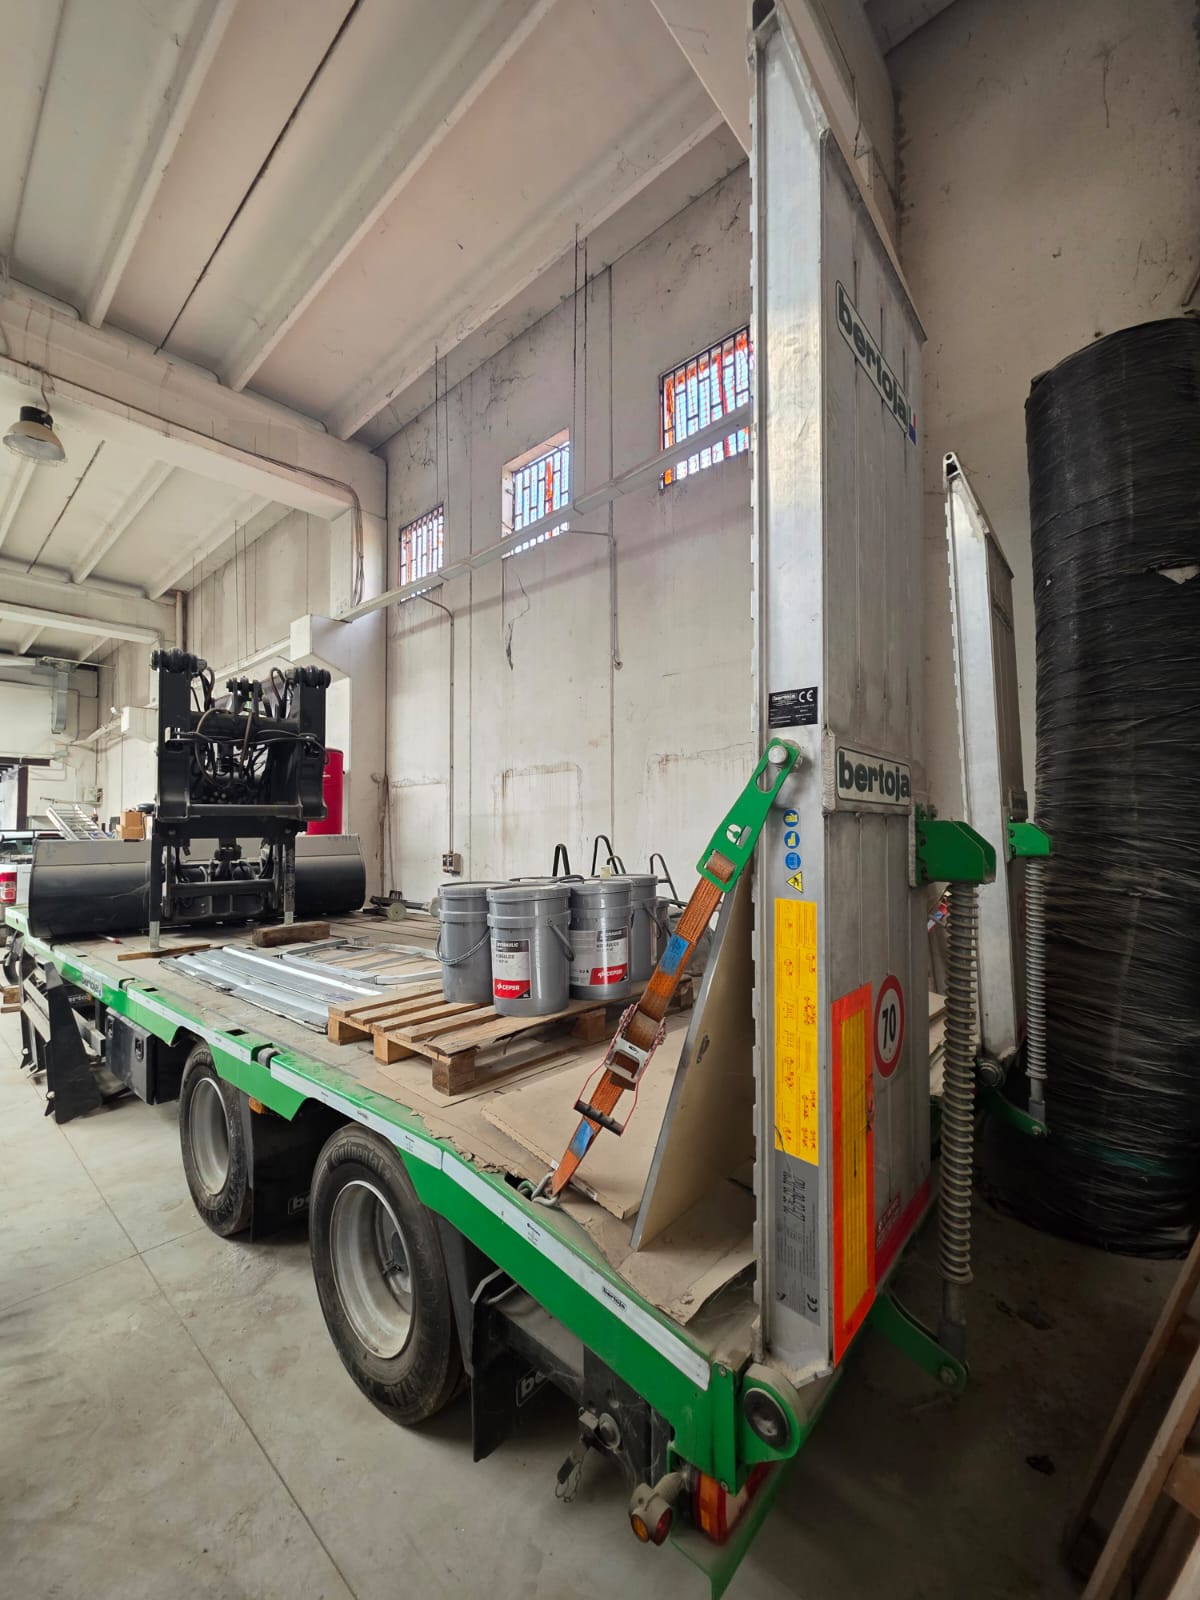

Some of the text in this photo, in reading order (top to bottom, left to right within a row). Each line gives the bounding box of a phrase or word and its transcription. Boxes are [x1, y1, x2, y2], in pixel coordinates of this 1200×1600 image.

[838, 286, 908, 426] bertoja
[838, 751, 911, 802] bertoja
[881, 1003, 897, 1050] 70
